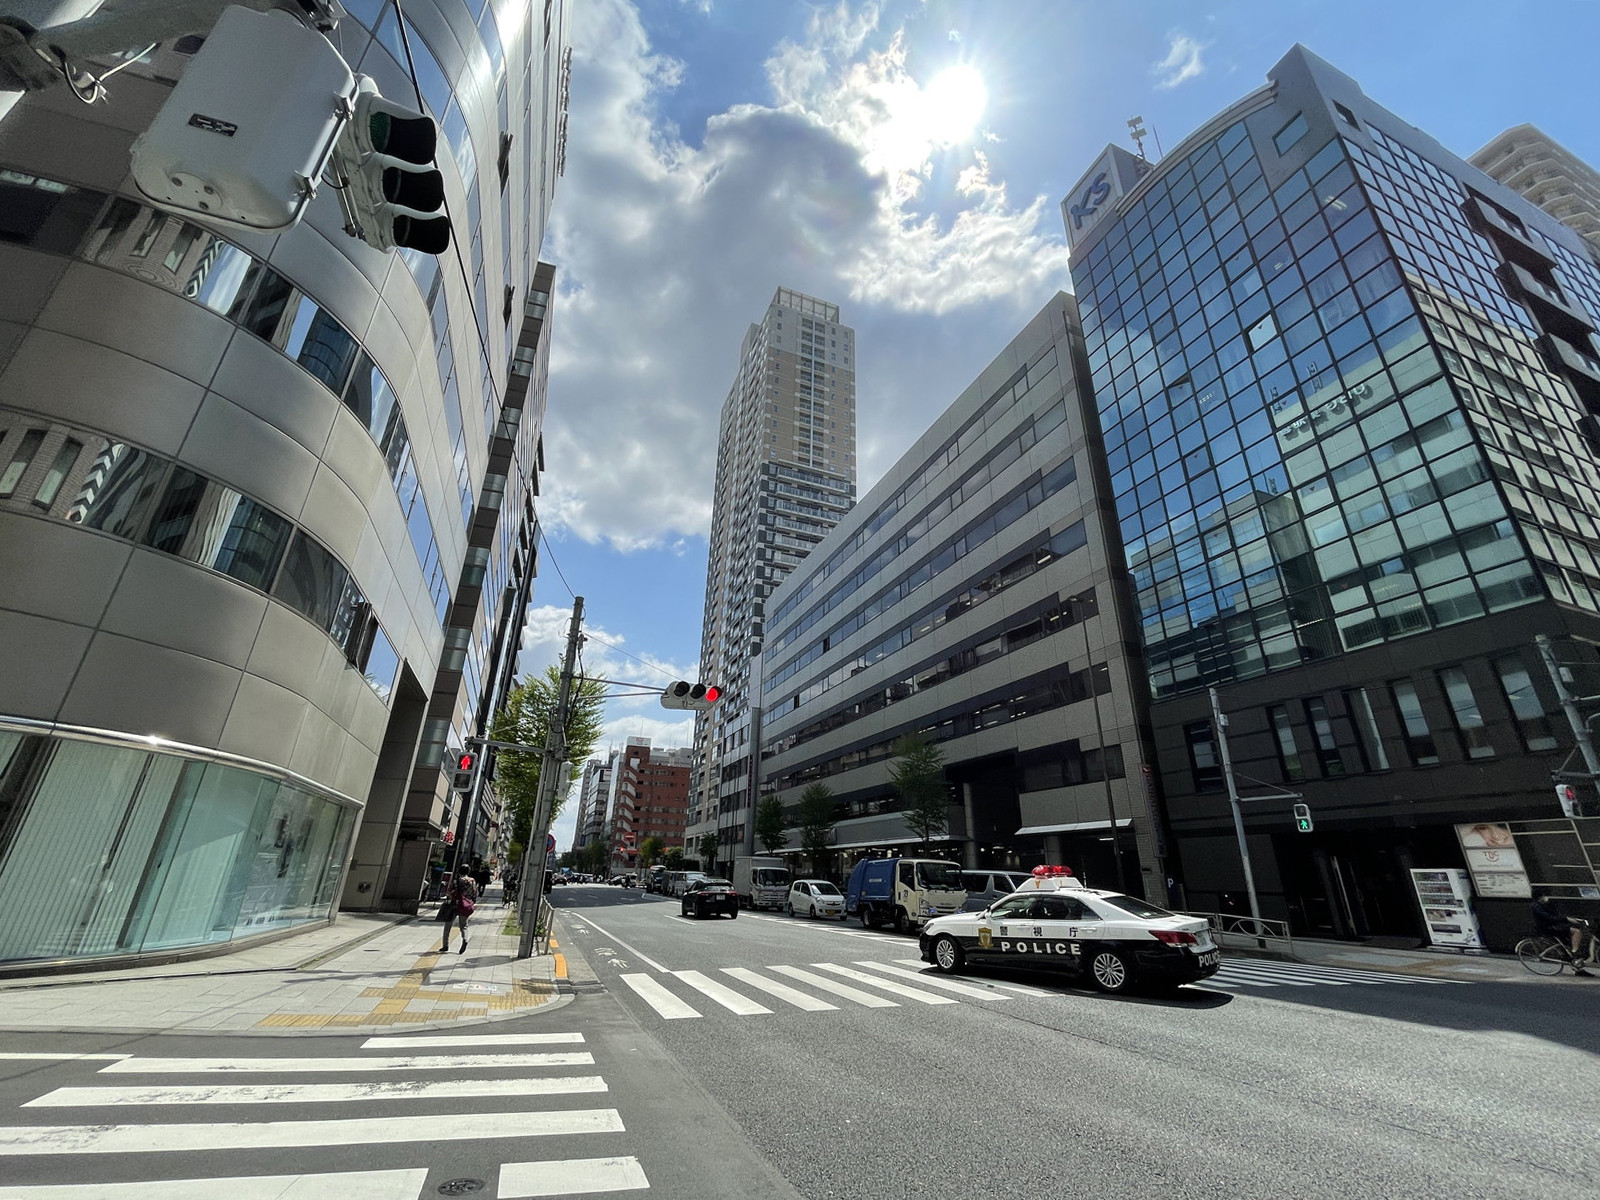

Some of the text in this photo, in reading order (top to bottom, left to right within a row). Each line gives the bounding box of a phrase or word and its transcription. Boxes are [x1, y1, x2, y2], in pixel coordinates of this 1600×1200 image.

[1070, 172, 1111, 230] KS
[1167, 877, 1174, 888] P
[999, 926, 1079, 938] 警視庁
[1000, 941, 1082, 956] POLICE
